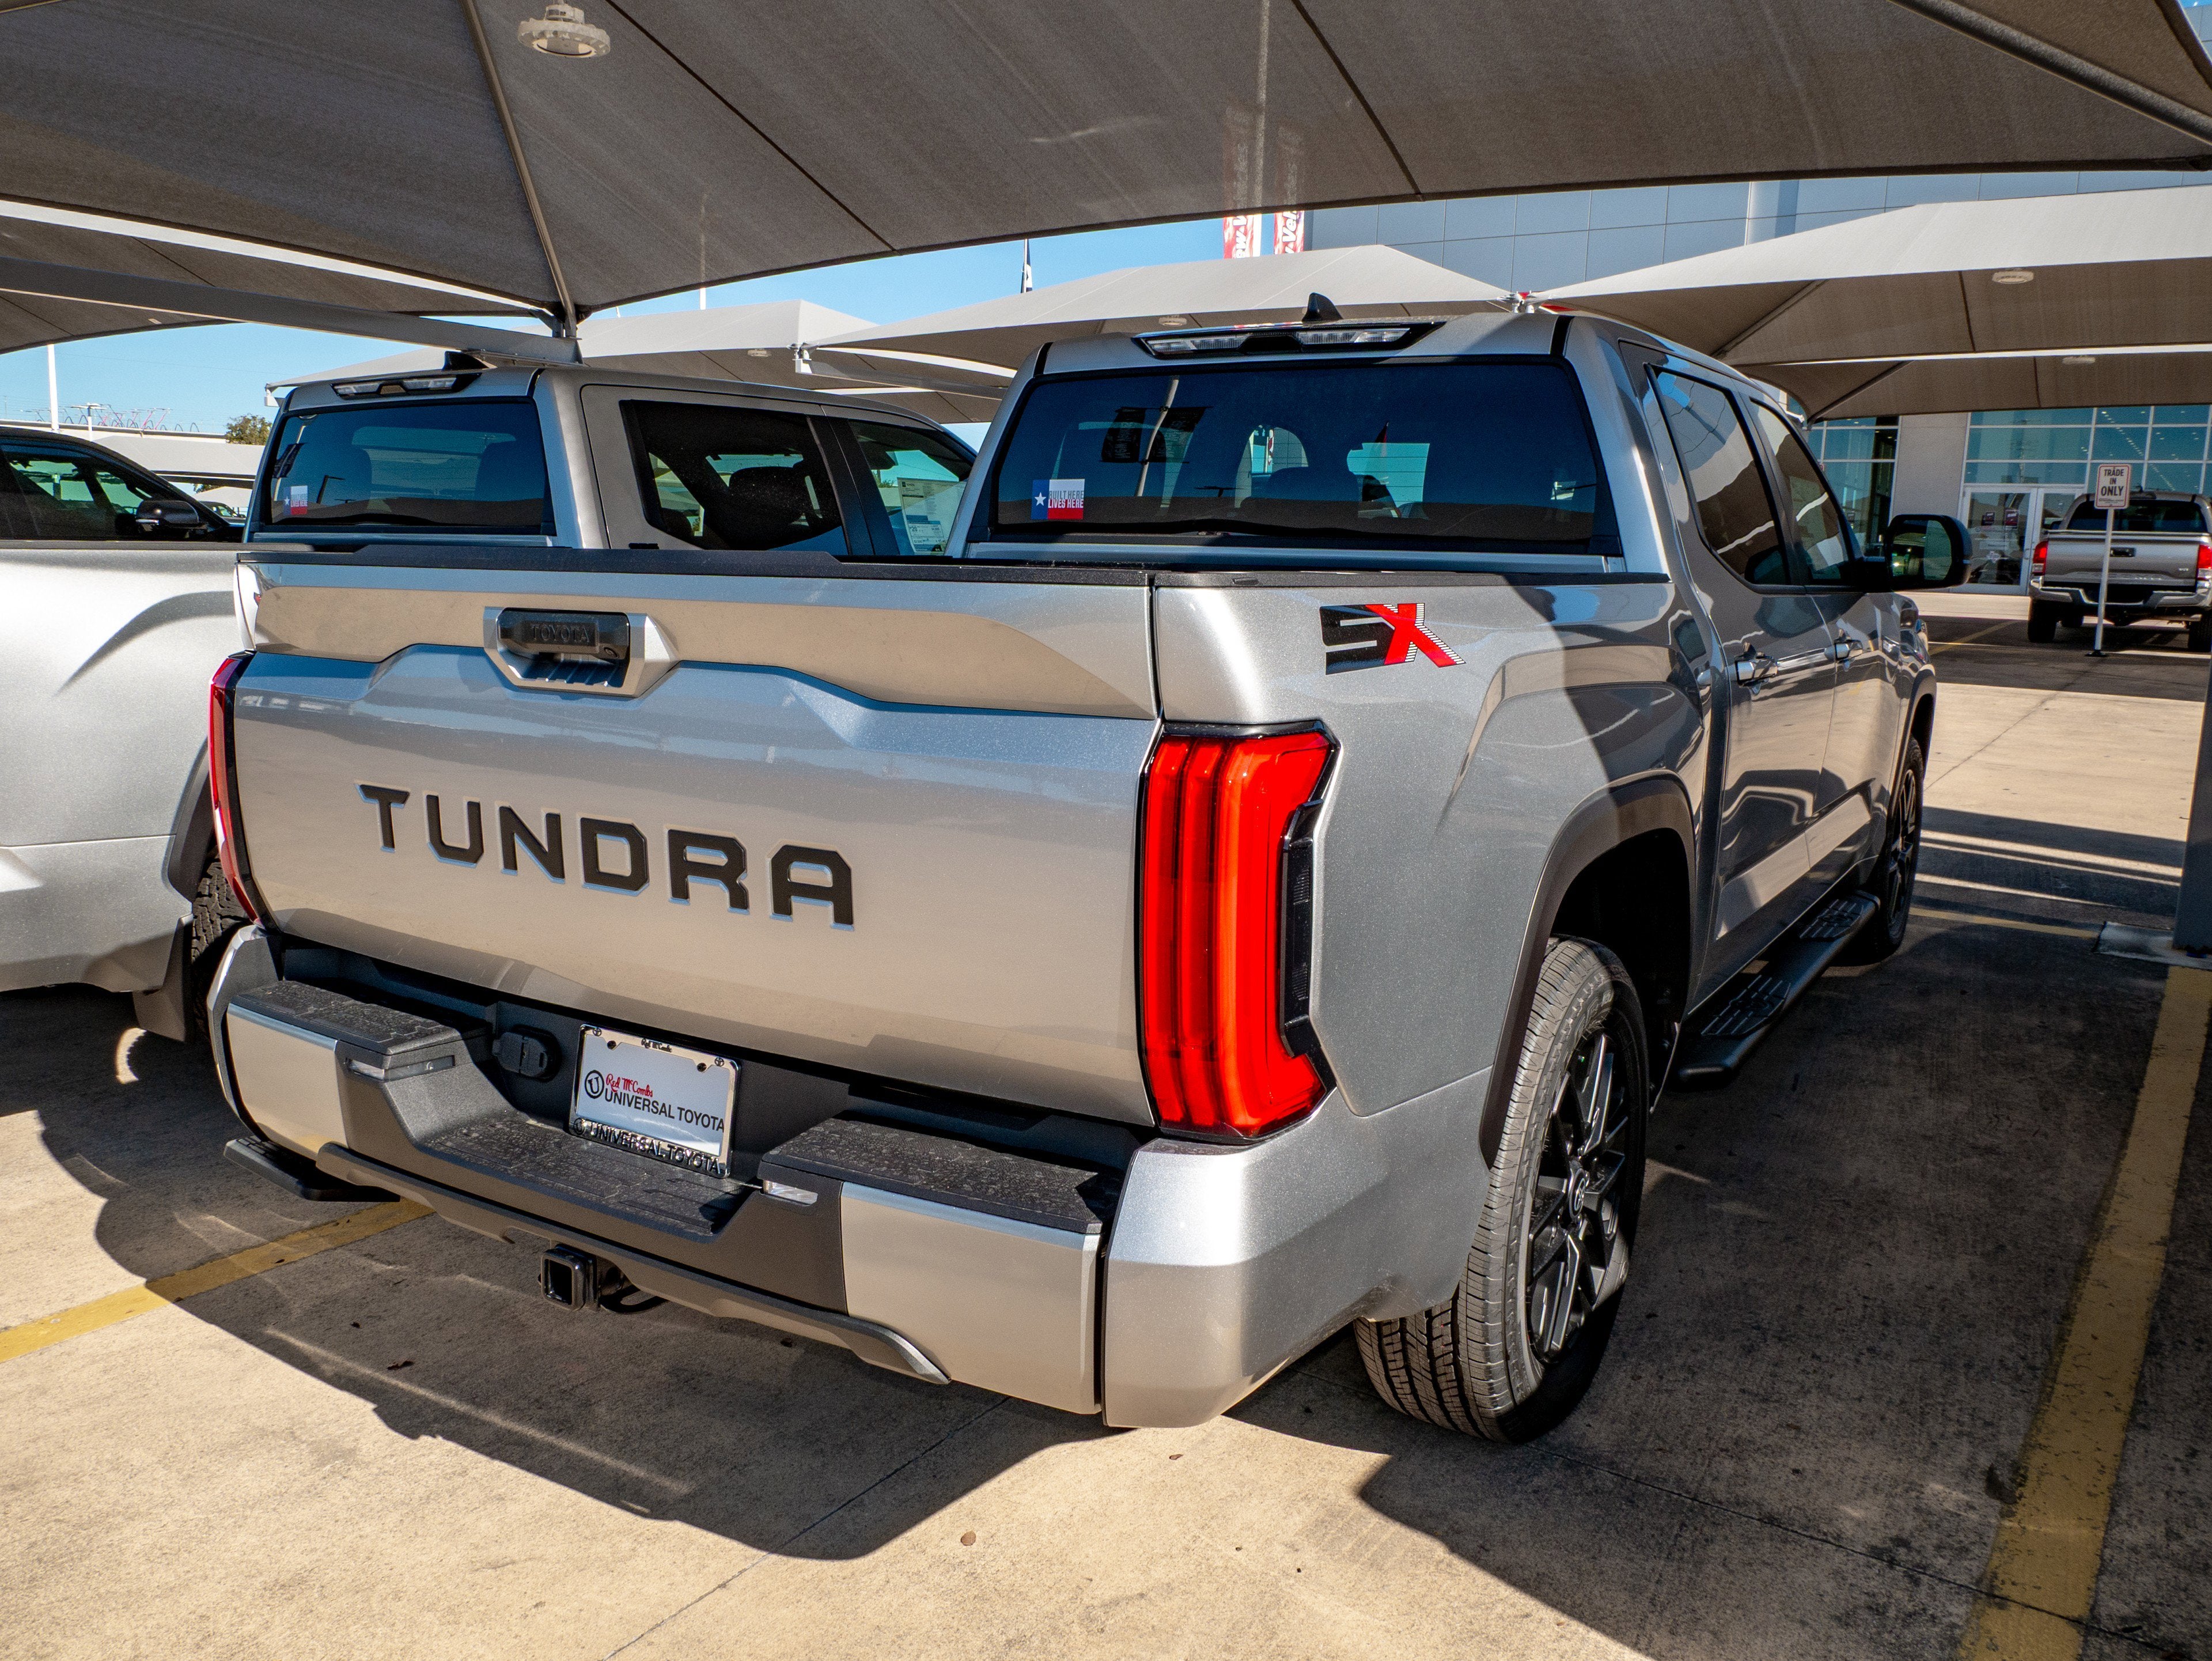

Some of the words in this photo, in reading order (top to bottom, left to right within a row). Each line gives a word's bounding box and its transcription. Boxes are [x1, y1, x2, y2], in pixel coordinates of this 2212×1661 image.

[2104, 469, 2124, 477] TRADE
[1048, 490, 1066, 500] BUILT
[1068, 490, 1084, 500] HERE
[2101, 486, 2124, 496] ONLY
[1048, 499, 1066, 509] LIVES
[1067, 499, 1084, 508] HERE
[530, 622, 590, 643] TOYOTA
[355, 781, 855, 931] TUNDRA
[605, 1073, 620, 1092] Red
[605, 1088, 675, 1119] UNIVERSAL
[677, 1107, 725, 1133] TOYOTA
[590, 1122, 666, 1158] UNIVERSAL
[666, 1144, 721, 1175] TOYOTA
